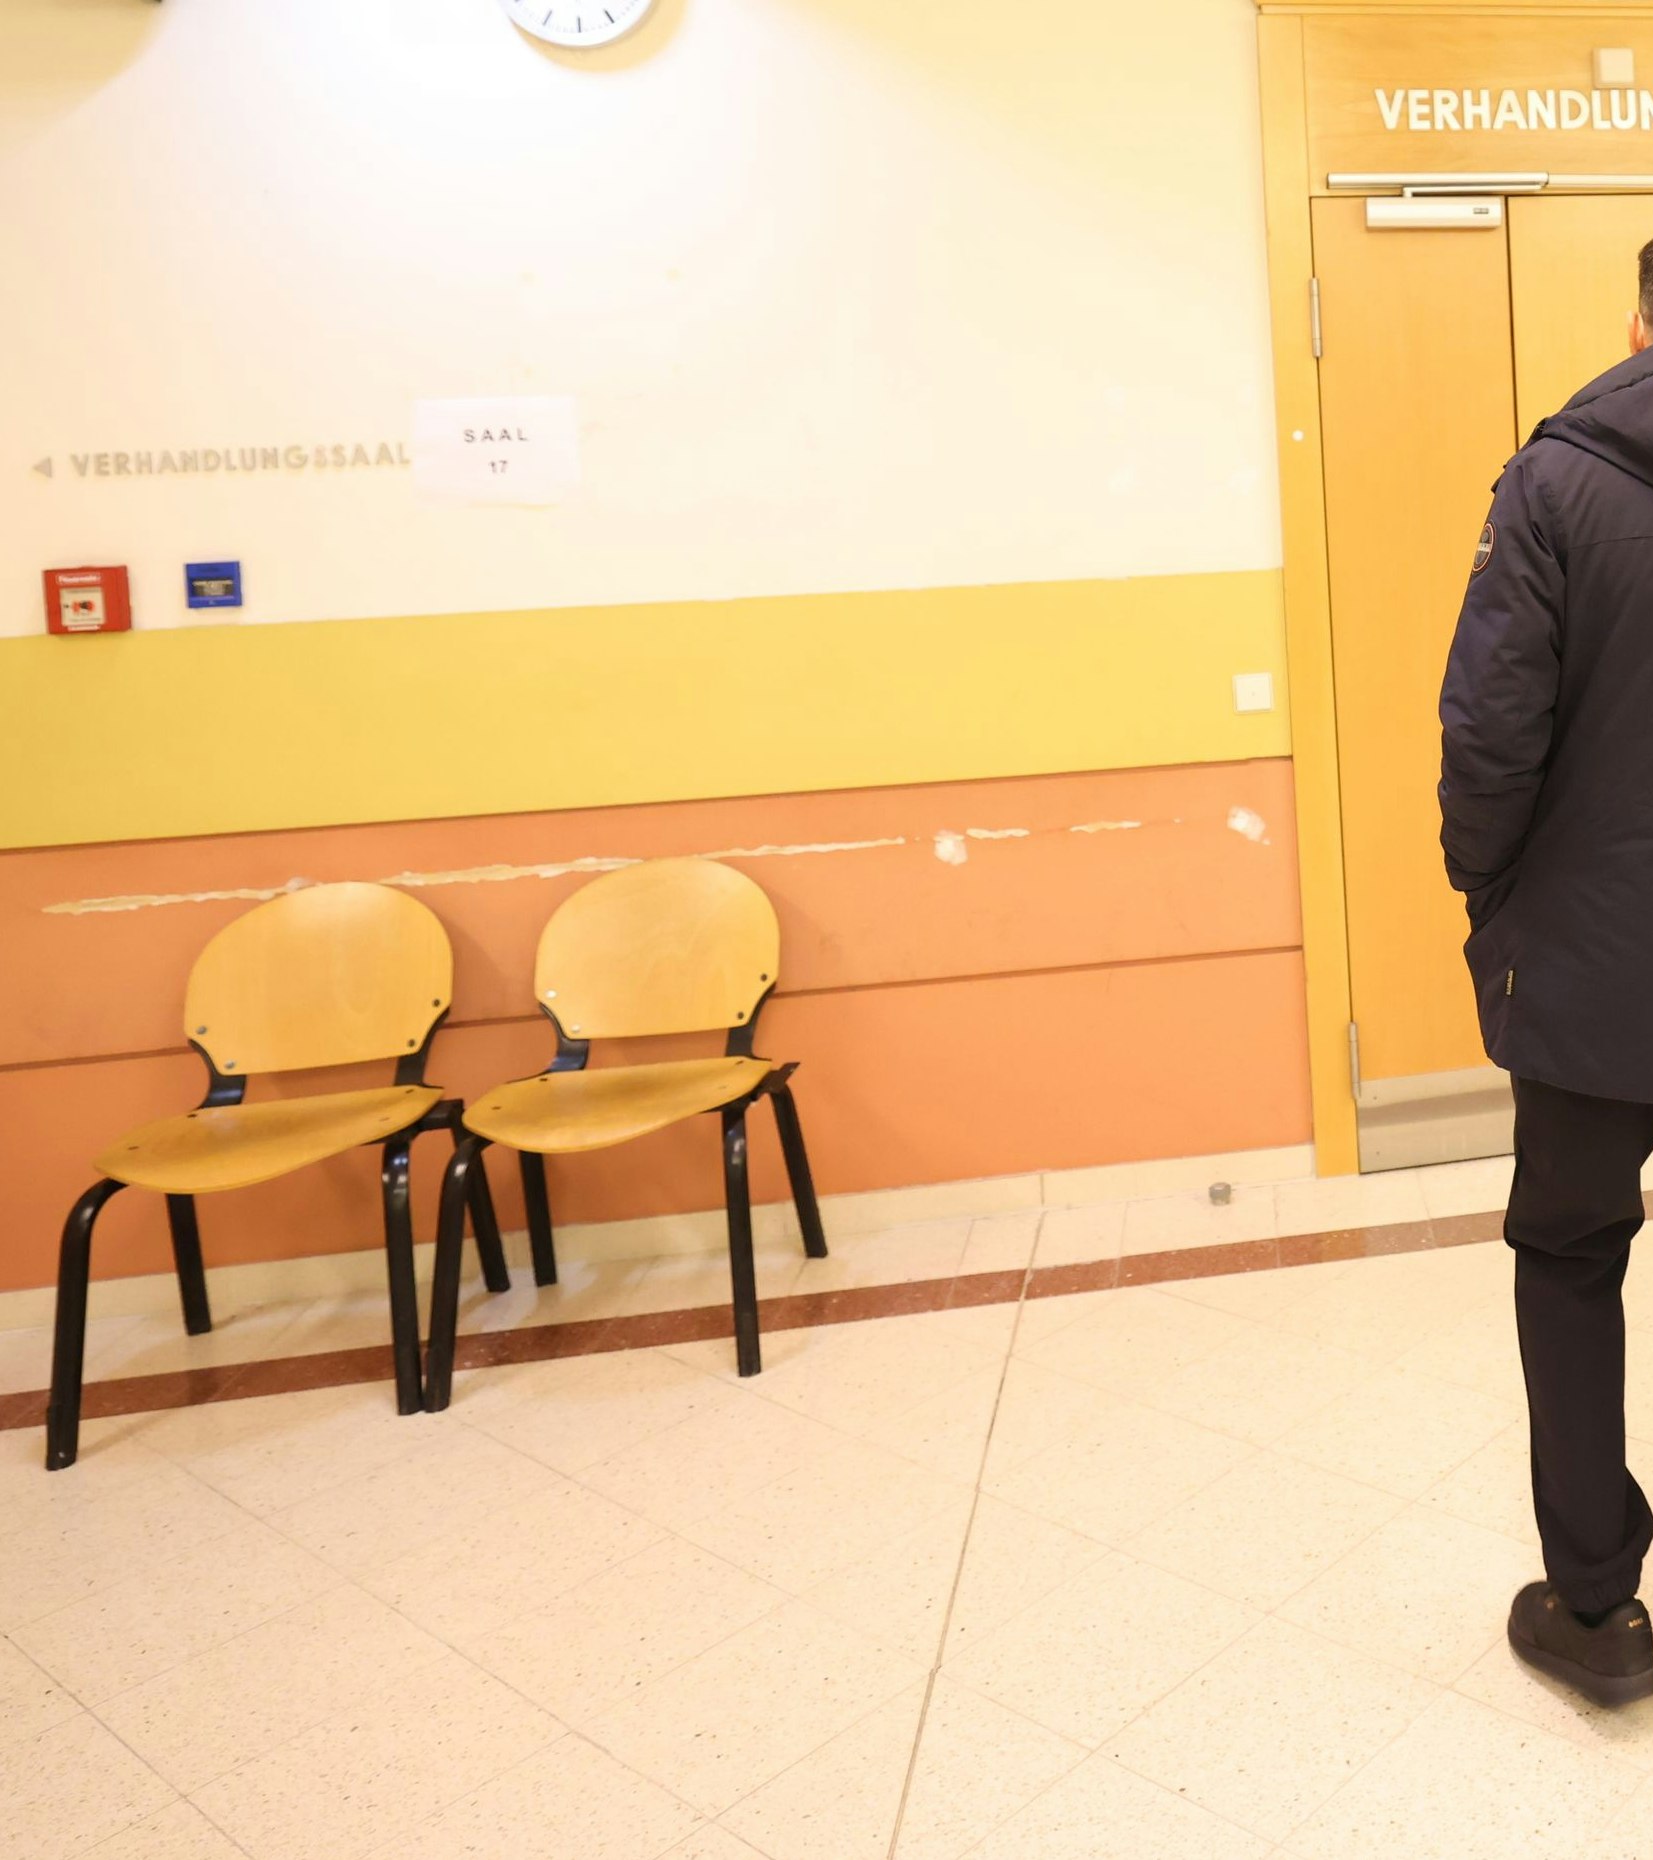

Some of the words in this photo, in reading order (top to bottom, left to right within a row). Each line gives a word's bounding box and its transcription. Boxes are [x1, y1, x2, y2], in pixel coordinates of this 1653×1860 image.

[463, 427, 529, 443] SAAL
[69, 442, 412, 478] VERHANDLUNGSSAAL
[488, 459, 508, 474] 17
